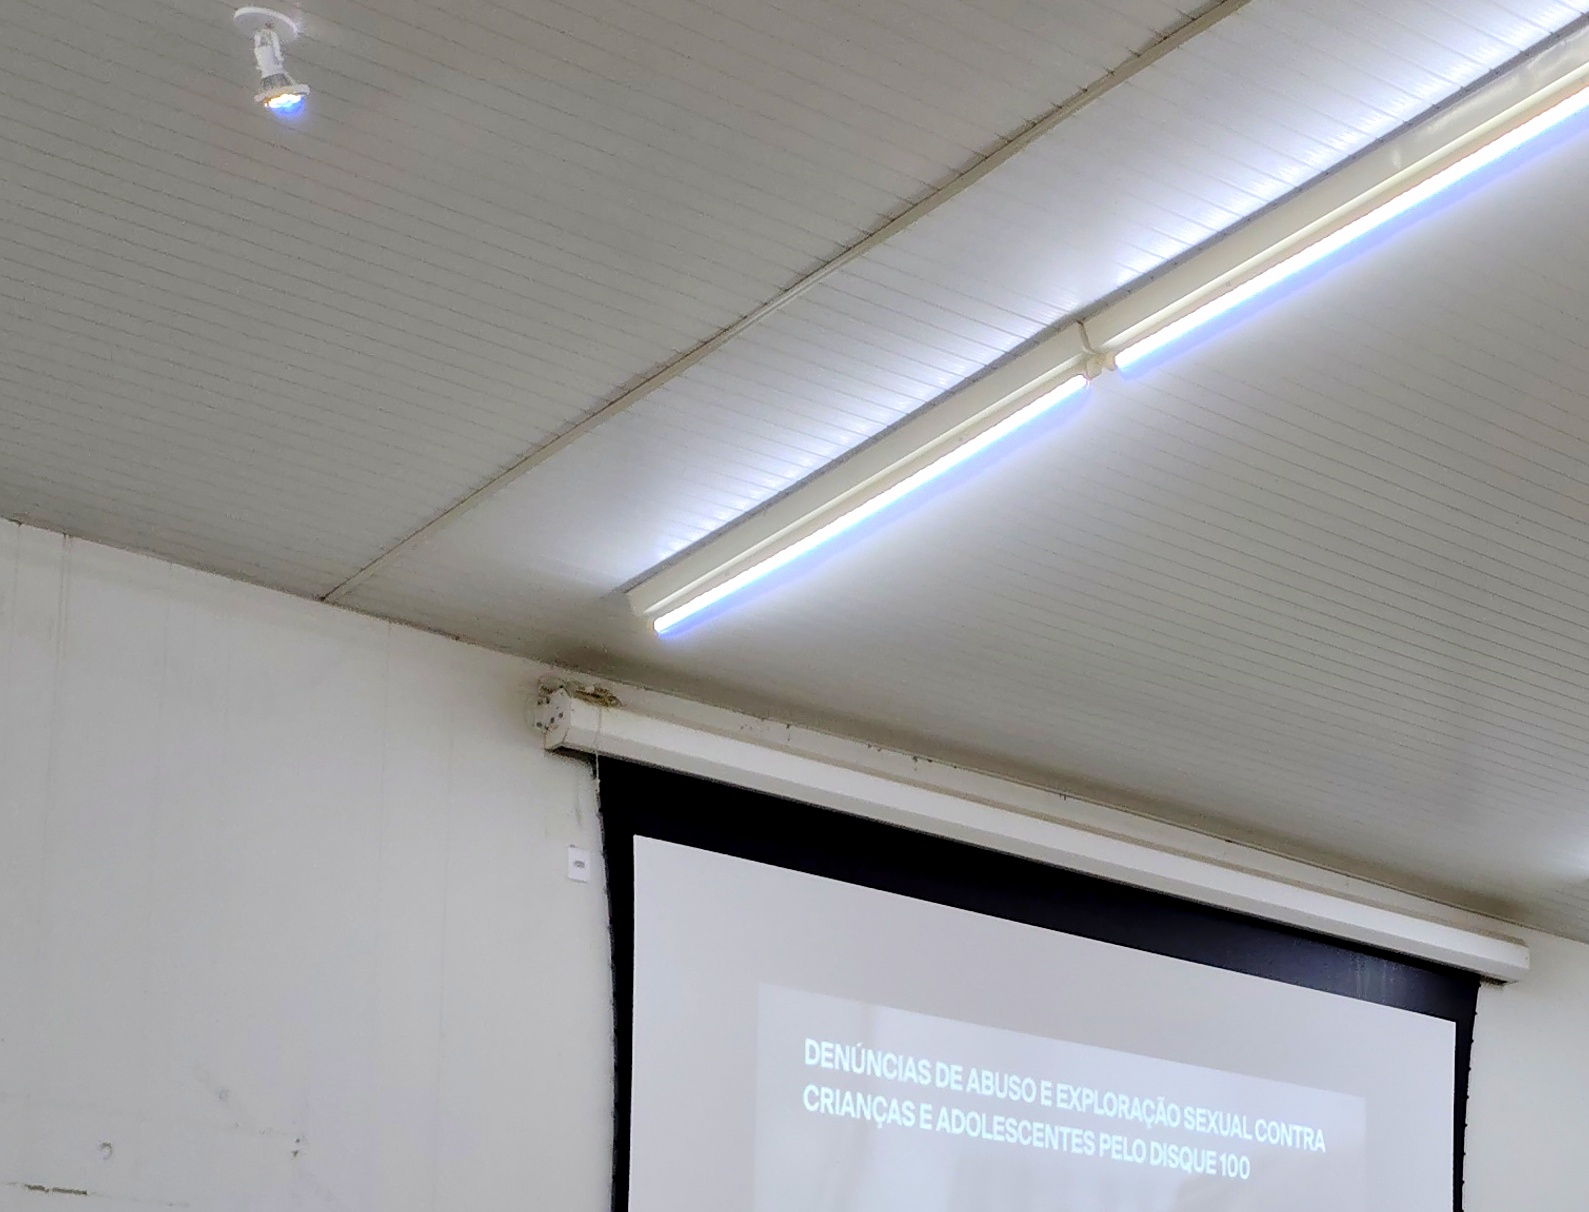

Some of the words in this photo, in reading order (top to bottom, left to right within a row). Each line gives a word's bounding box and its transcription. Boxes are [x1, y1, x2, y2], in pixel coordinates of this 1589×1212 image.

[803, 1084, 916, 1129] CRIANÇAS
[919, 1102, 933, 1130] E
[936, 1105, 1095, 1156] ADOLESCENTES
[1099, 1132, 1146, 1163] PELO
[1150, 1141, 1217, 1174] DISQUE
[1219, 1153, 1251, 1180] 100
[804, 1038, 932, 1086] DENÚNCIAS
[935, 1061, 963, 1091] DE
[966, 1067, 1037, 1104] ABUSO
[1041, 1079, 1053, 1107] E
[1056, 1082, 1181, 1129] EXPLORAÇÃO
[1184, 1106, 1253, 1140] SEXUAL
[1255, 1118, 1327, 1153] CONTRA
